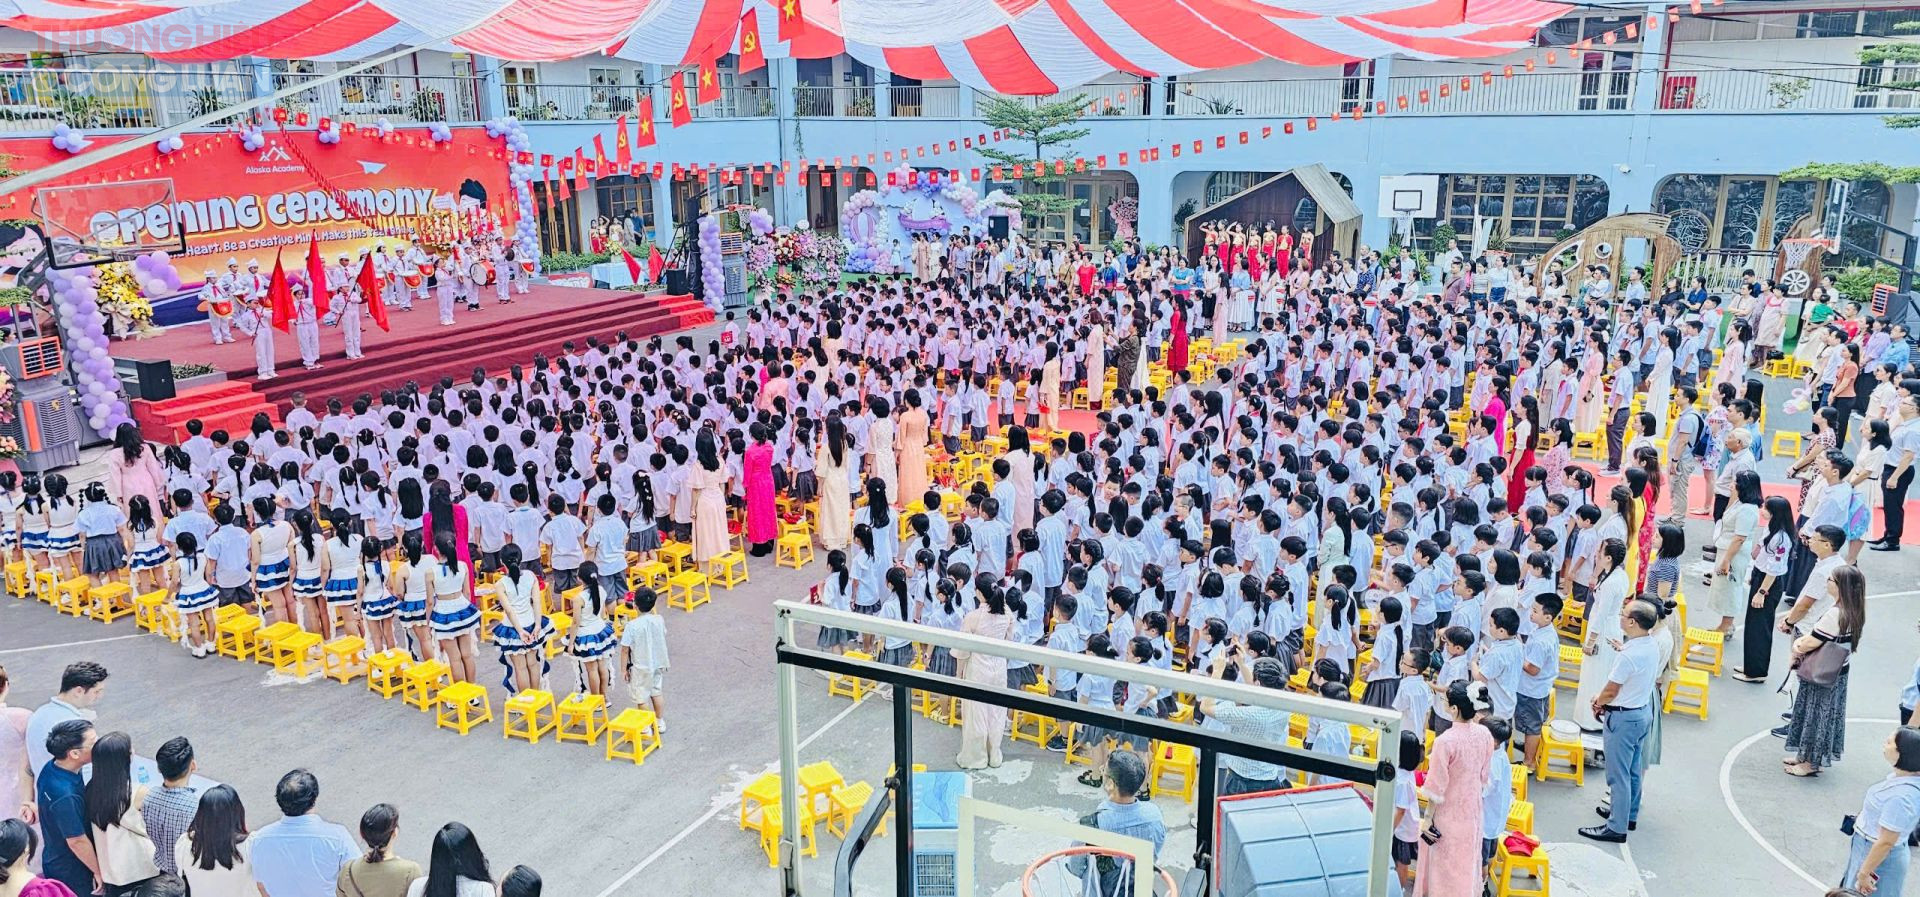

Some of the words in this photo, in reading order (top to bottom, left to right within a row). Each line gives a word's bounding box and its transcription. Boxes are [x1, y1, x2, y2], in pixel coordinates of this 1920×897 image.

[246, 166, 271, 174] Alaska
[272, 165, 305, 173] Academy
[223, 240, 238, 252] Be
[239, 240, 247, 250] a
[248, 234, 294, 249] Creative
[322, 230, 347, 241] Make
